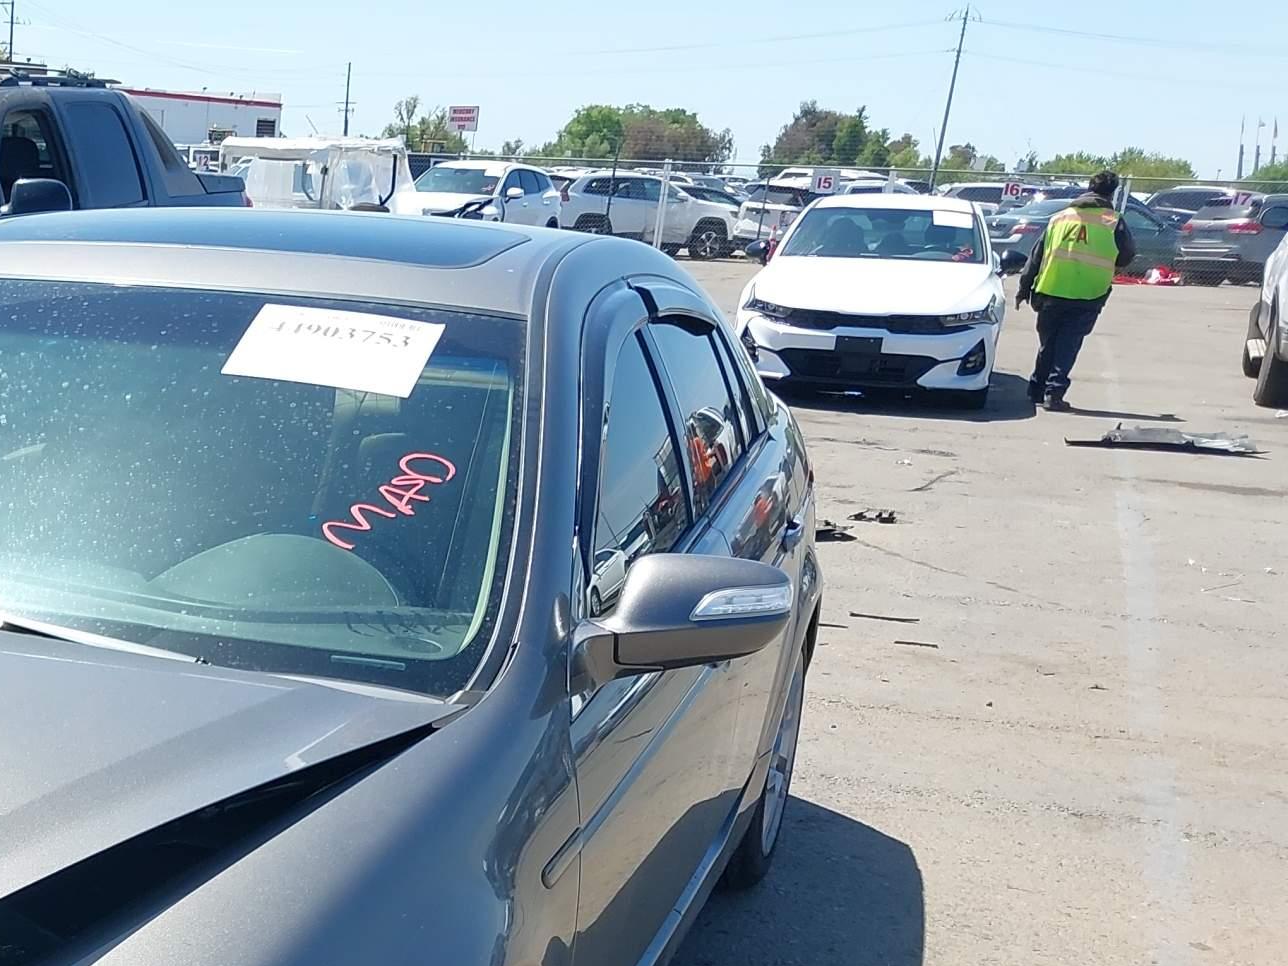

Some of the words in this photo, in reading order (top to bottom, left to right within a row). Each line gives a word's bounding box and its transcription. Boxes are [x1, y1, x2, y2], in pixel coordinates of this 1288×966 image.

[198, 155, 209, 167] 12
[817, 177, 832, 190] 15
[1004, 183, 1020, 196] 16
[1233, 192, 1252, 206] 17
